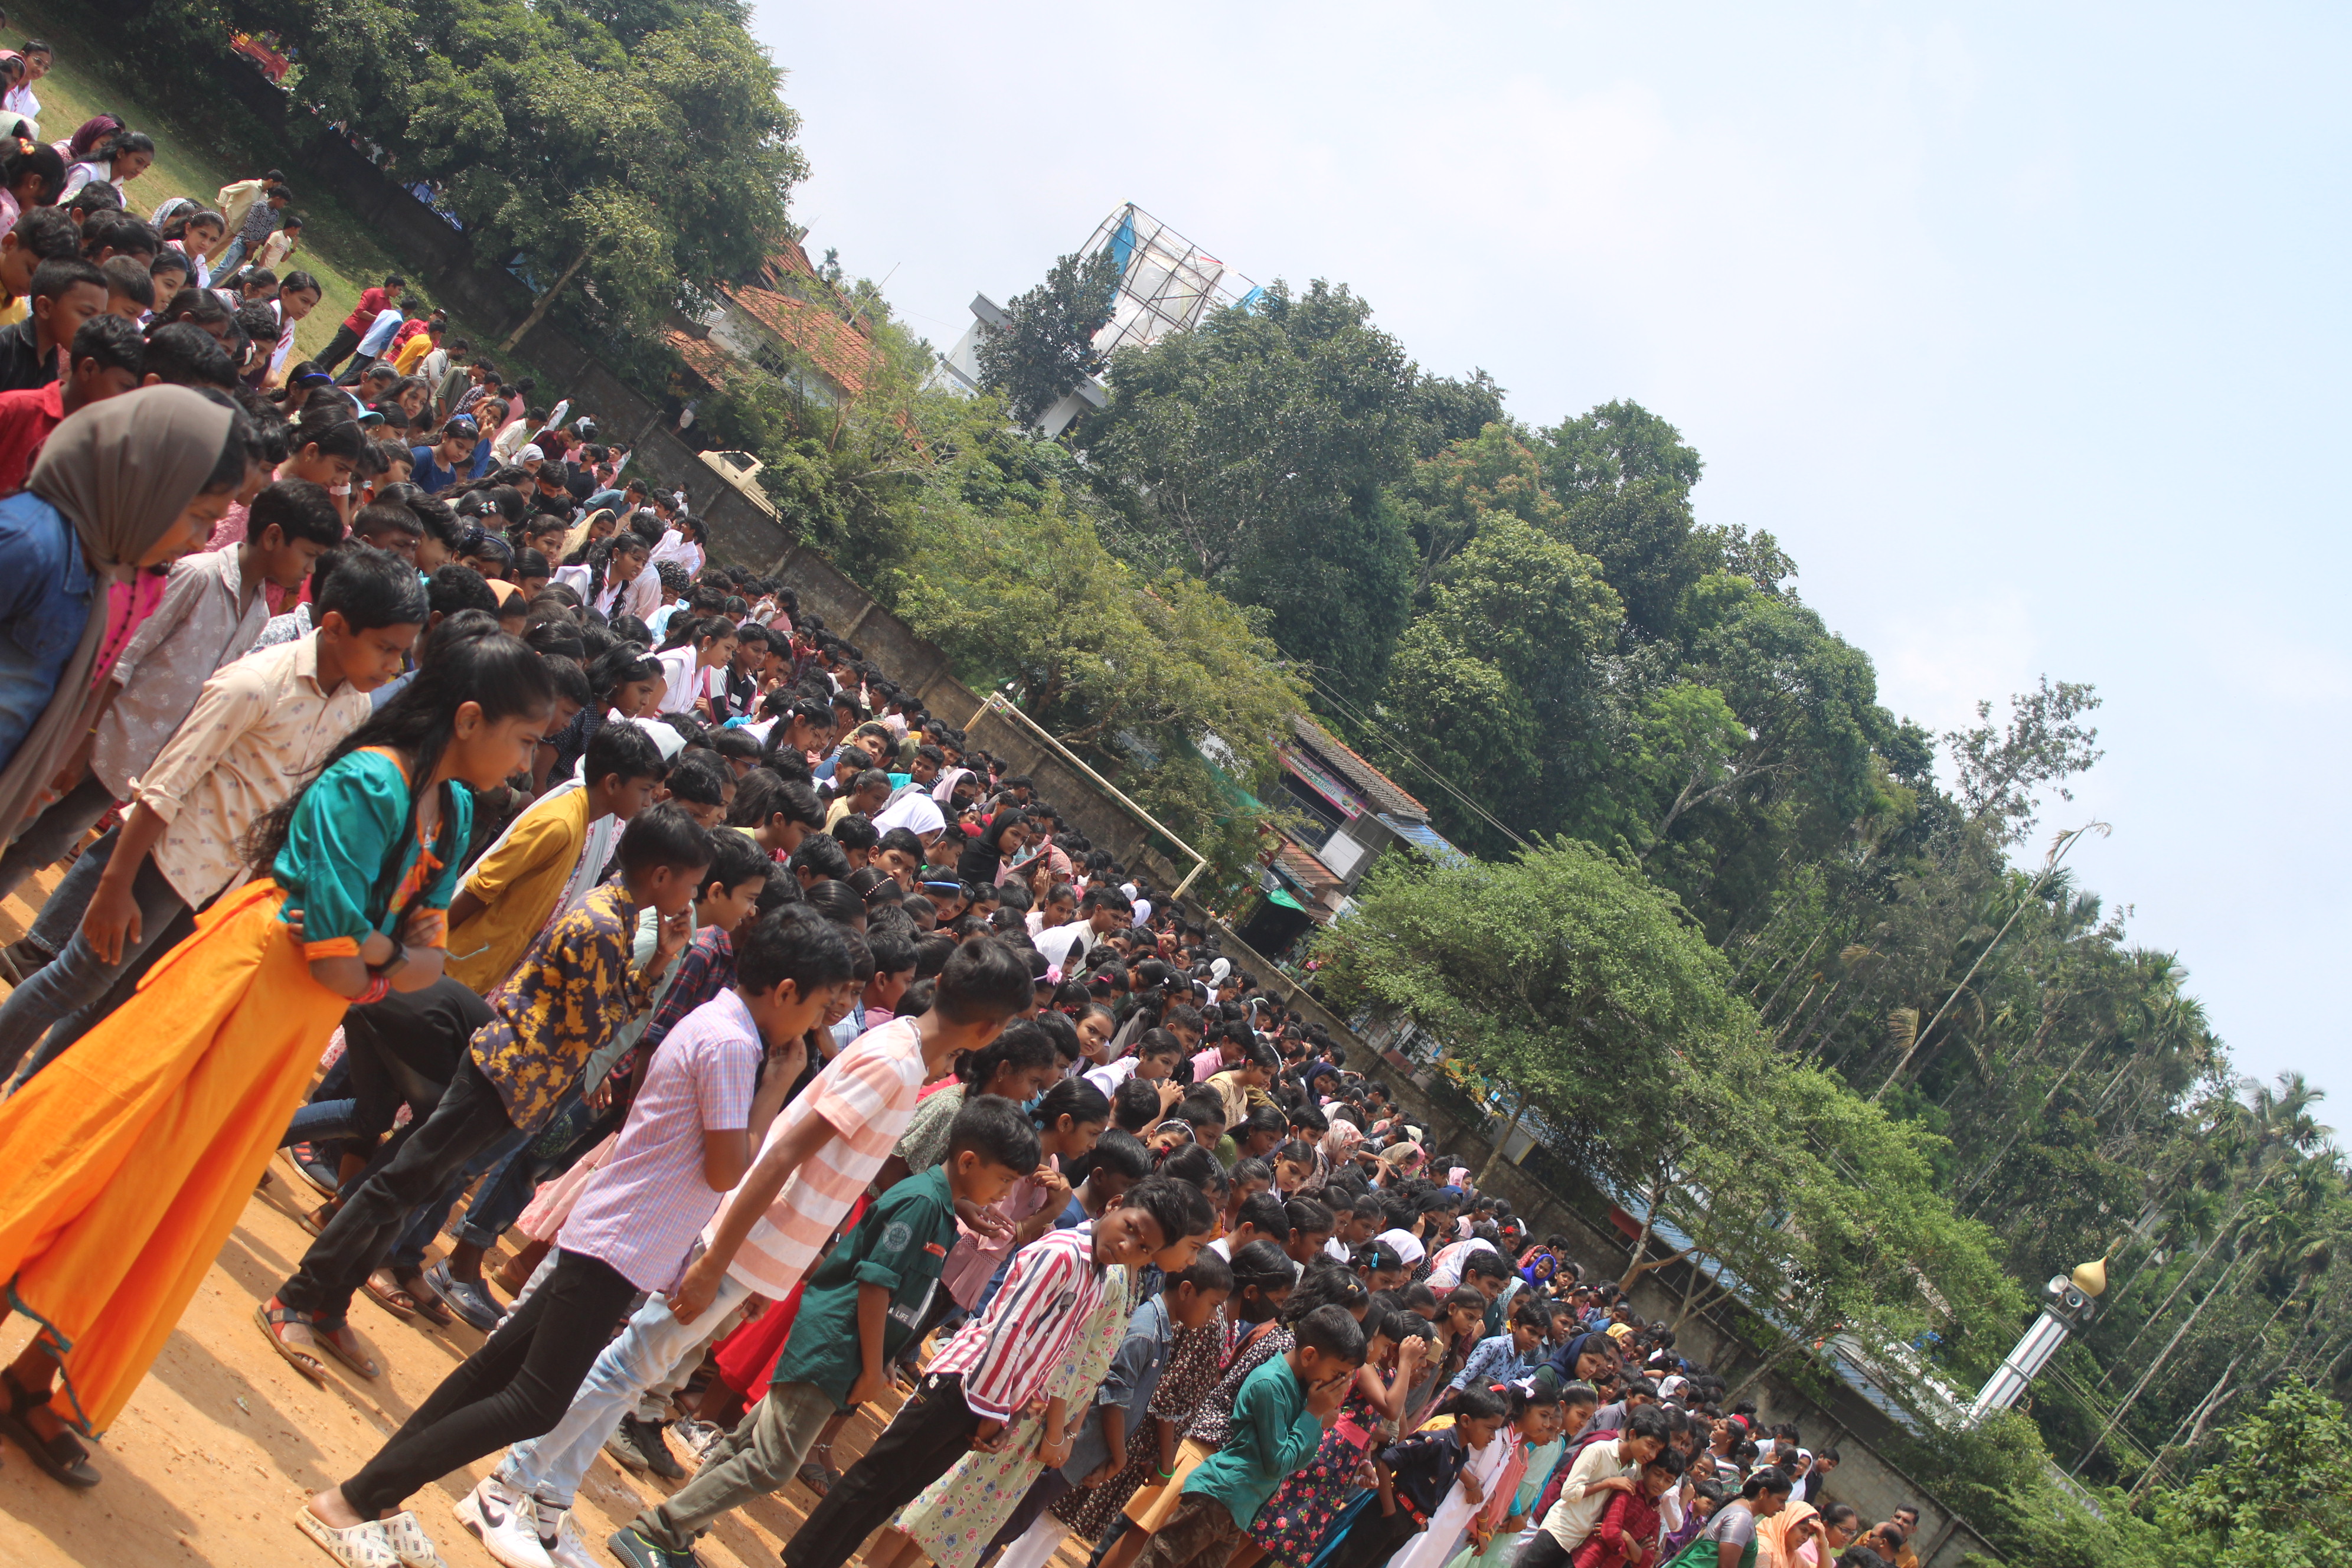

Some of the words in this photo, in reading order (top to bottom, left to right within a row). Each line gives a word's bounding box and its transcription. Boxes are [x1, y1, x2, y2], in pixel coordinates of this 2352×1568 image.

[1288, 756, 1316, 780] NAINOOS
[1315, 778, 1337, 796] STORE
[895, 1309, 909, 1322] LIFE
